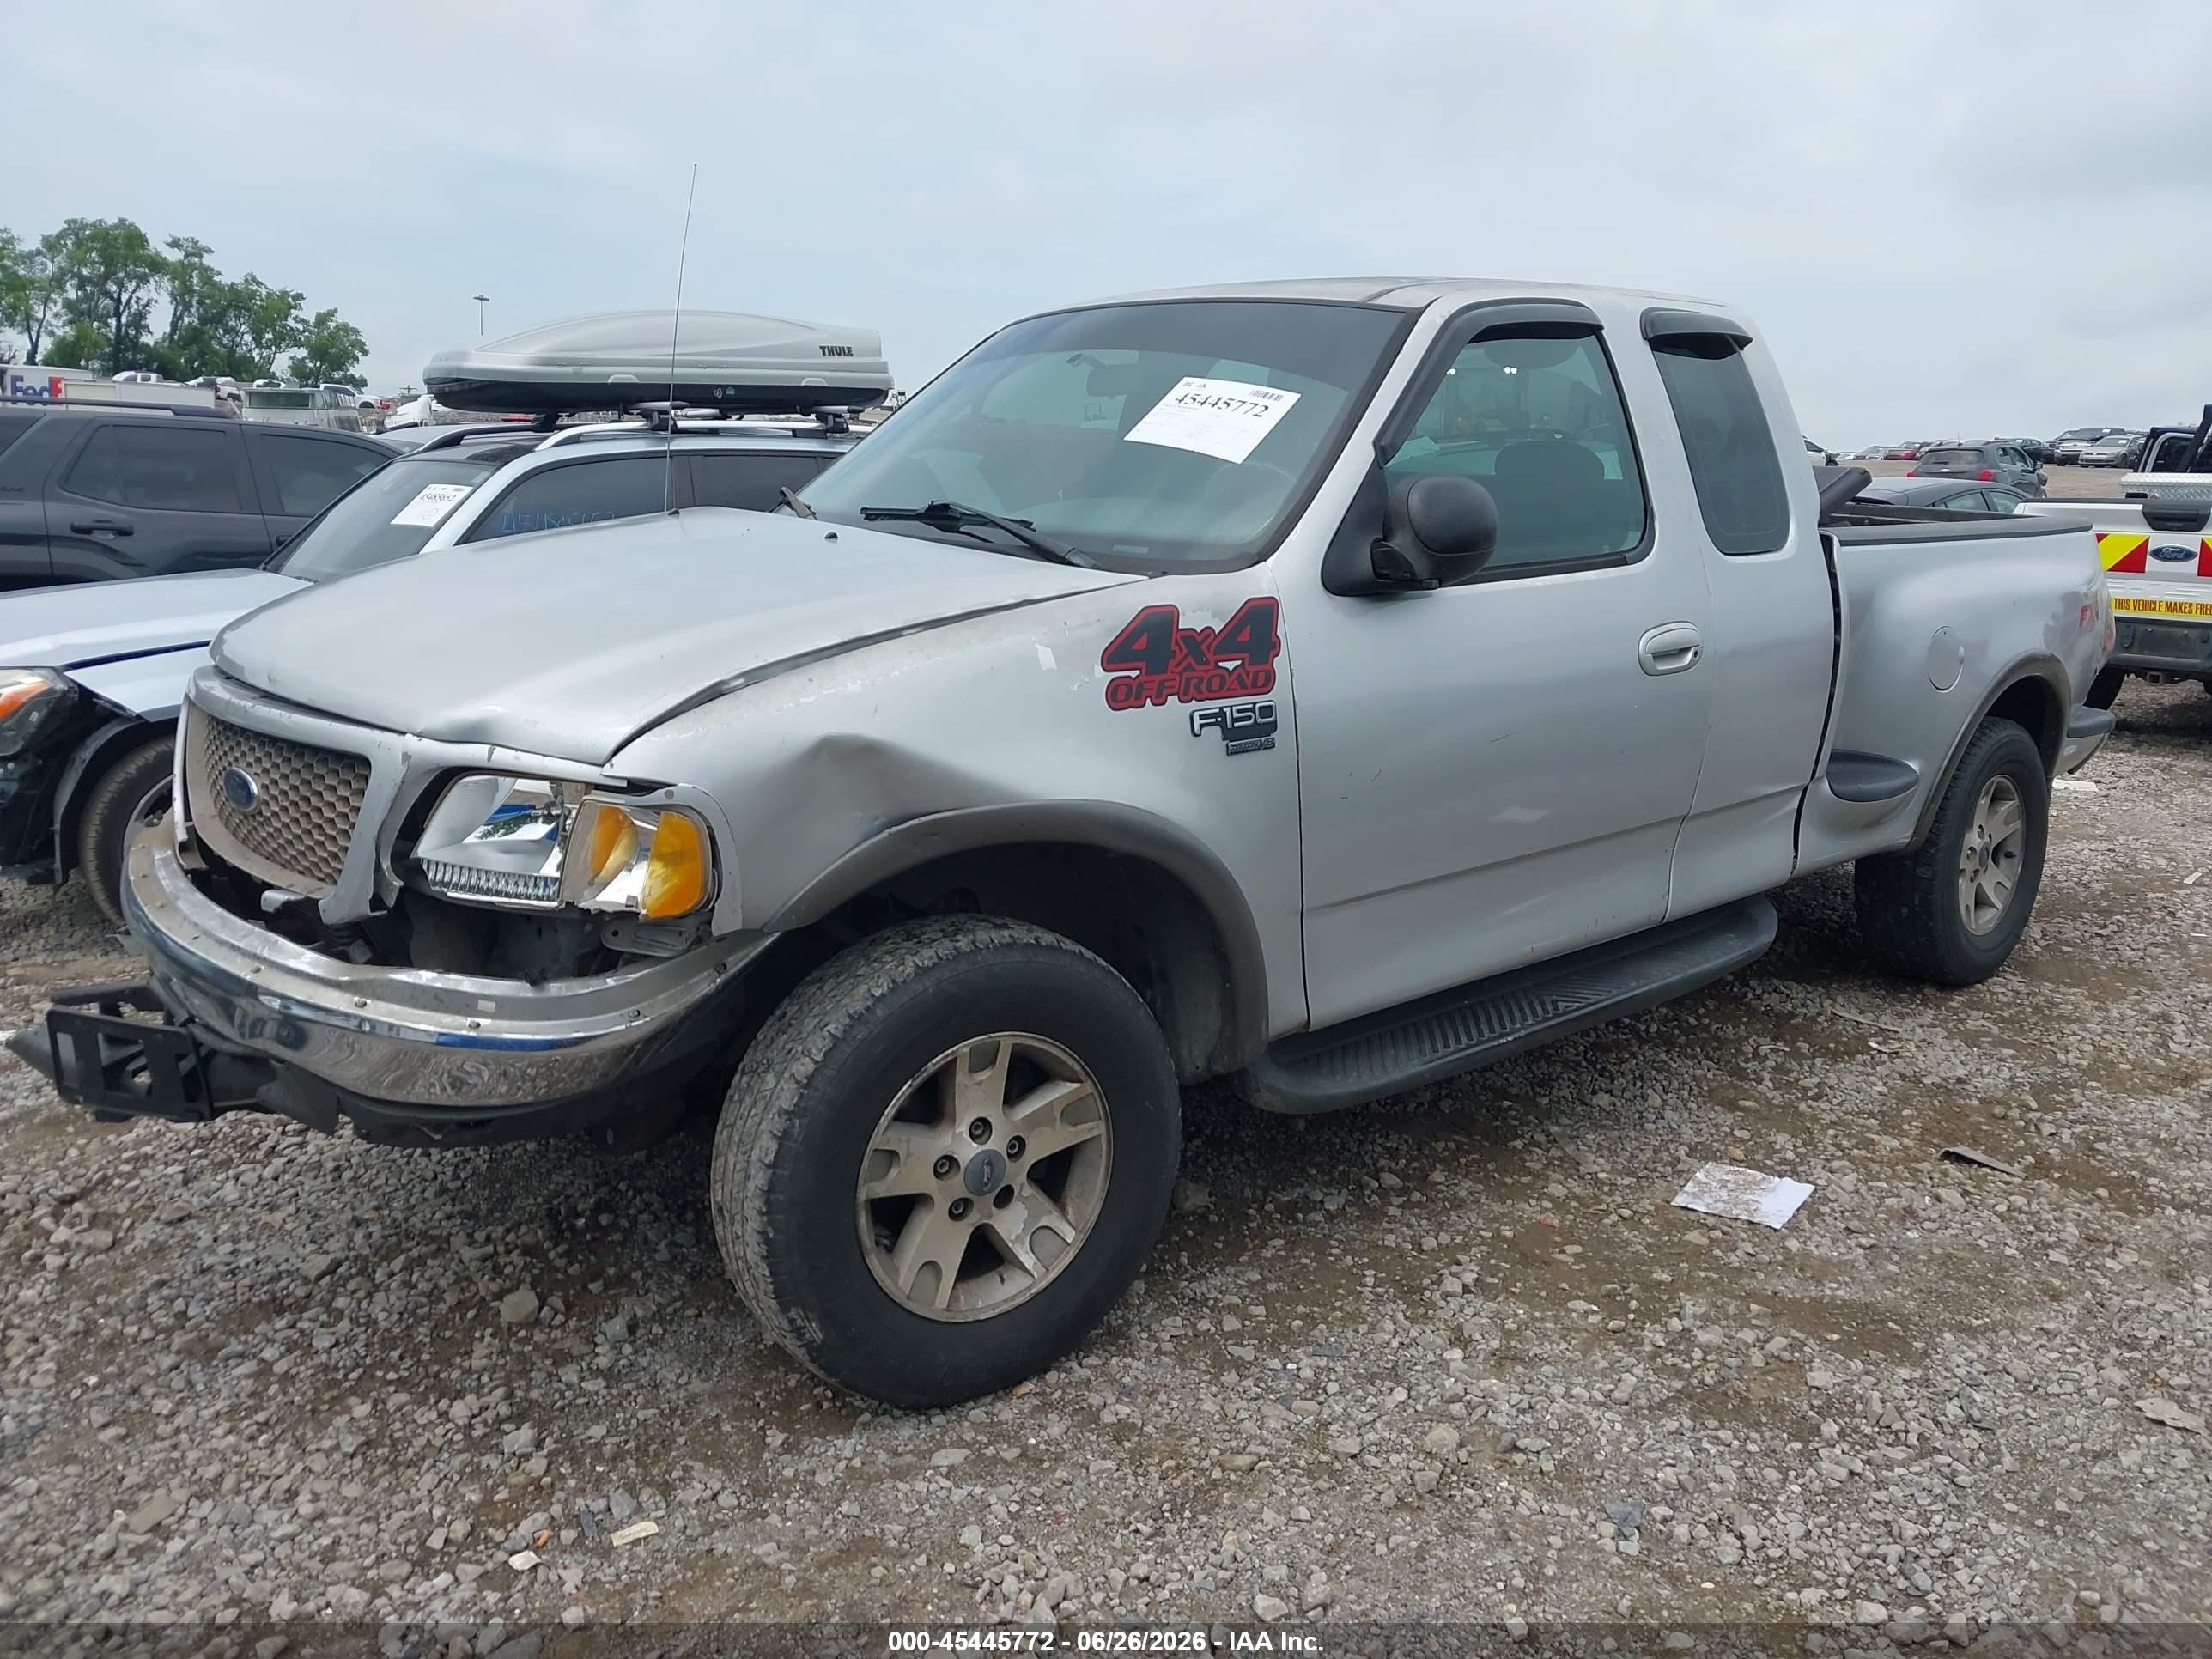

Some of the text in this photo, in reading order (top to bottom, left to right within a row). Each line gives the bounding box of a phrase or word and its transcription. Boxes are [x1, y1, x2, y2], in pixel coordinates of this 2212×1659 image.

[818, 345, 854, 357] THULE
[1175, 392, 1270, 418] 45445772
[2114, 598, 2130, 610] THIS
[2132, 599, 2162, 612] VEHICLE
[2165, 601, 2192, 614] MAKES
[1101, 596, 1281, 677] 4x4
[1107, 669, 1276, 710] OFF ROAD
